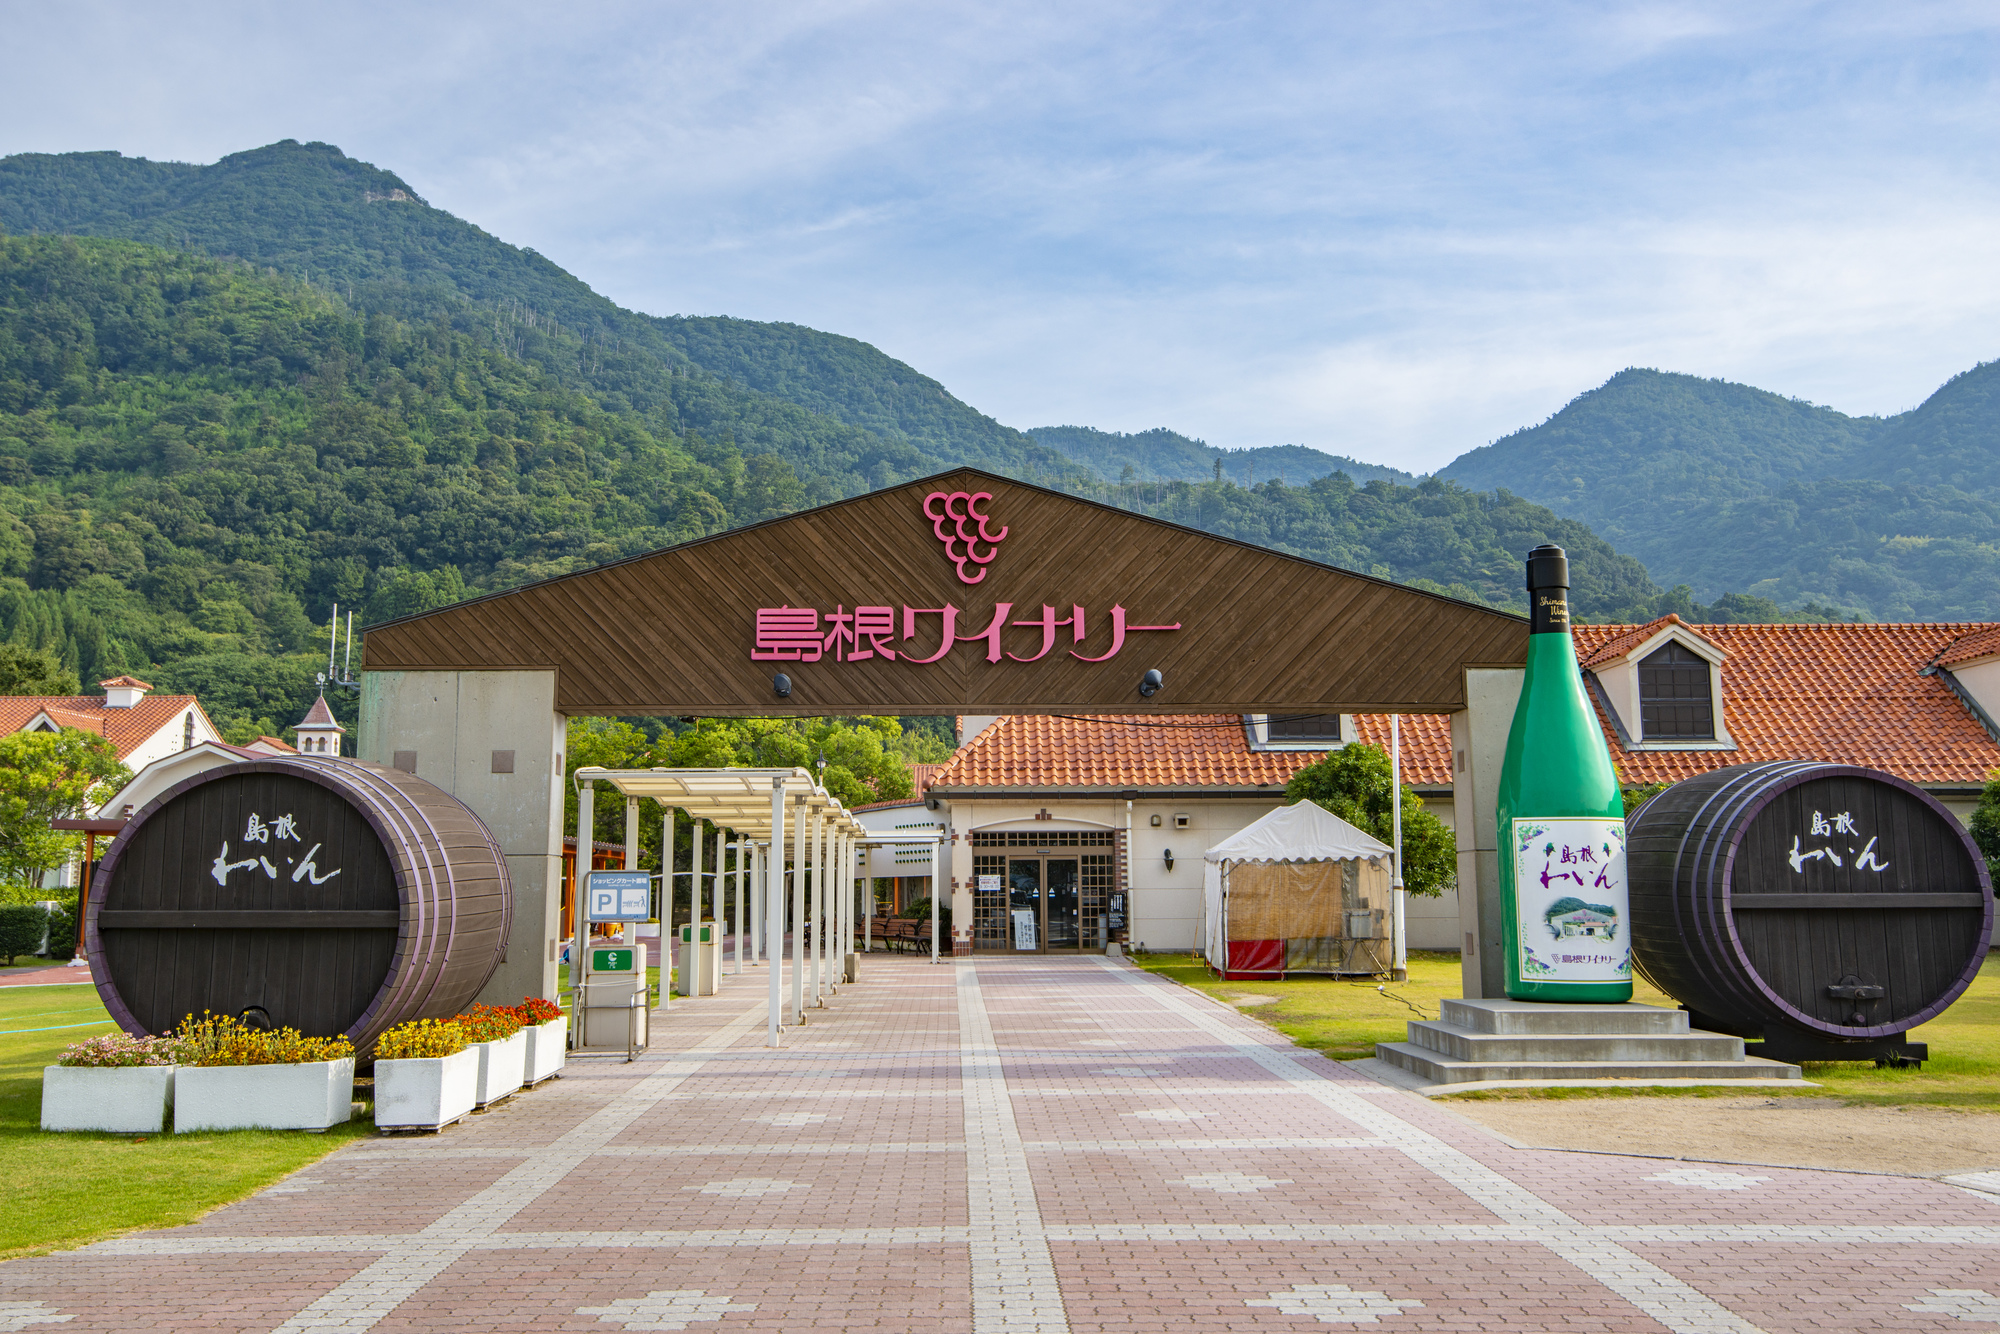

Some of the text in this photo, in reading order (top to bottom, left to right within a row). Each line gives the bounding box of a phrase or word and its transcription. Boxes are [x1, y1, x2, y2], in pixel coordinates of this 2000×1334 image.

[751, 602, 1182, 664] 島根ワイナリー
[244, 812, 301, 844] 島根
[1811, 810, 1859, 837] 島根
[211, 840, 341, 887] わいん
[1560, 844, 1598, 865] 島根
[1789, 835, 1889, 873] わいん
[1539, 861, 1618, 889] わいん
[1561, 954, 1617, 964] 島根ワイナリー
